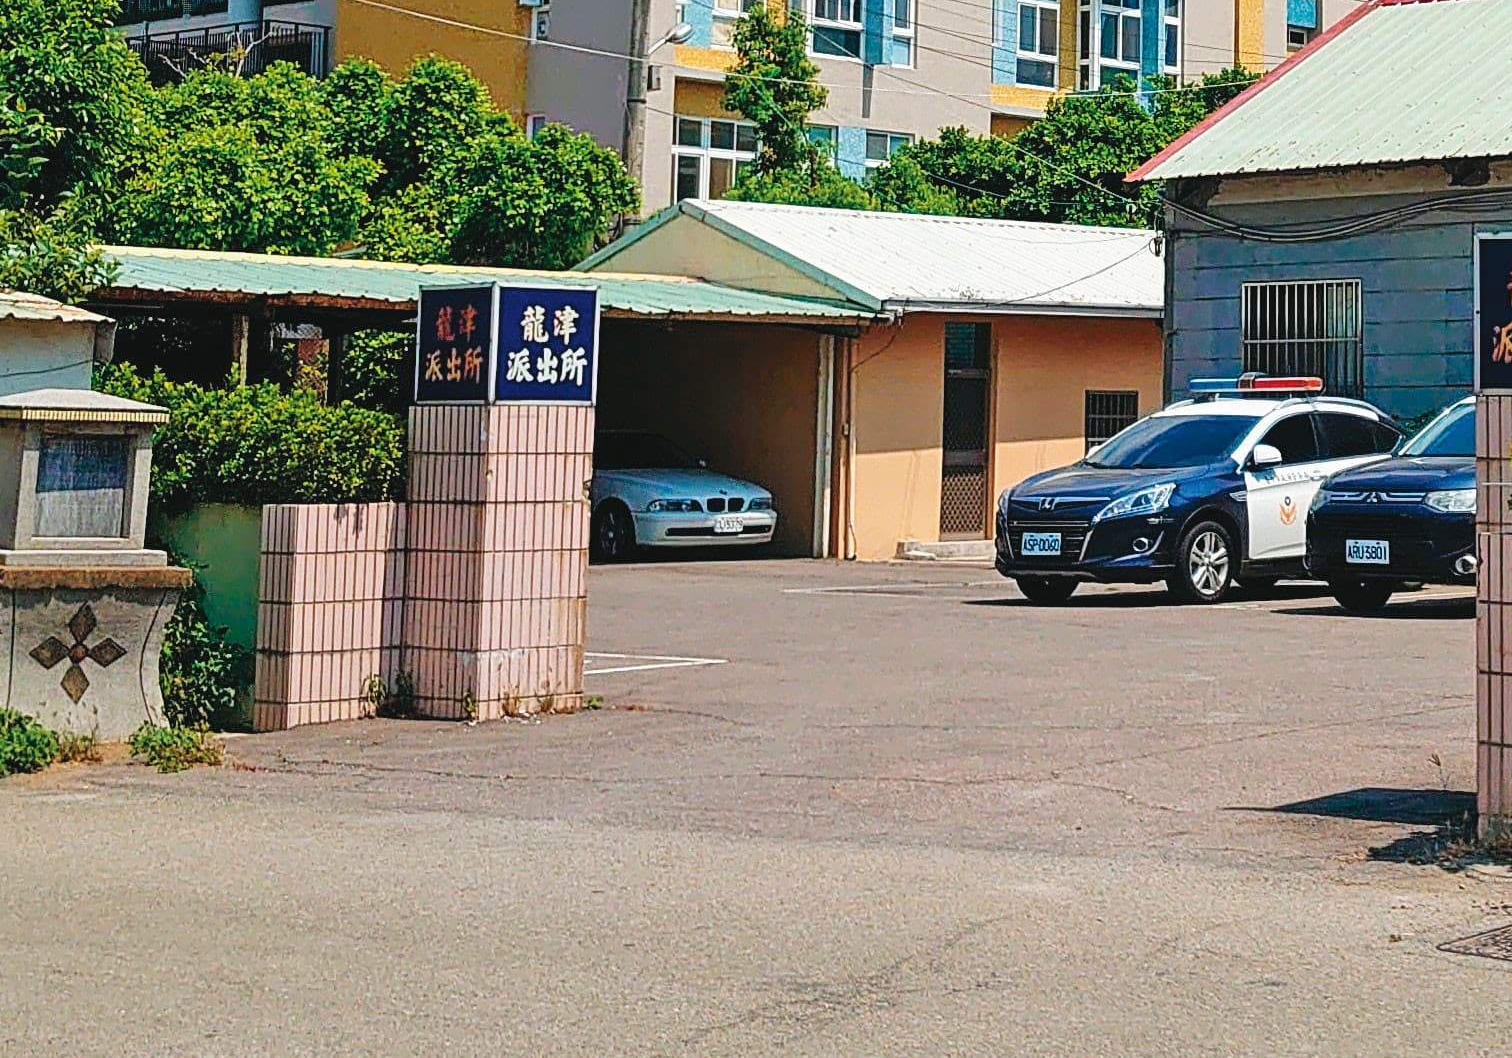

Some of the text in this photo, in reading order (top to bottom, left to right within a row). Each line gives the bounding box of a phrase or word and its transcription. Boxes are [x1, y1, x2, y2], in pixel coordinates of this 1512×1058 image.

[435, 304, 478, 342] 龍津
[520, 305, 580, 345] 龍津
[425, 345, 483, 384] 派出所
[506, 347, 588, 386] 派出所
